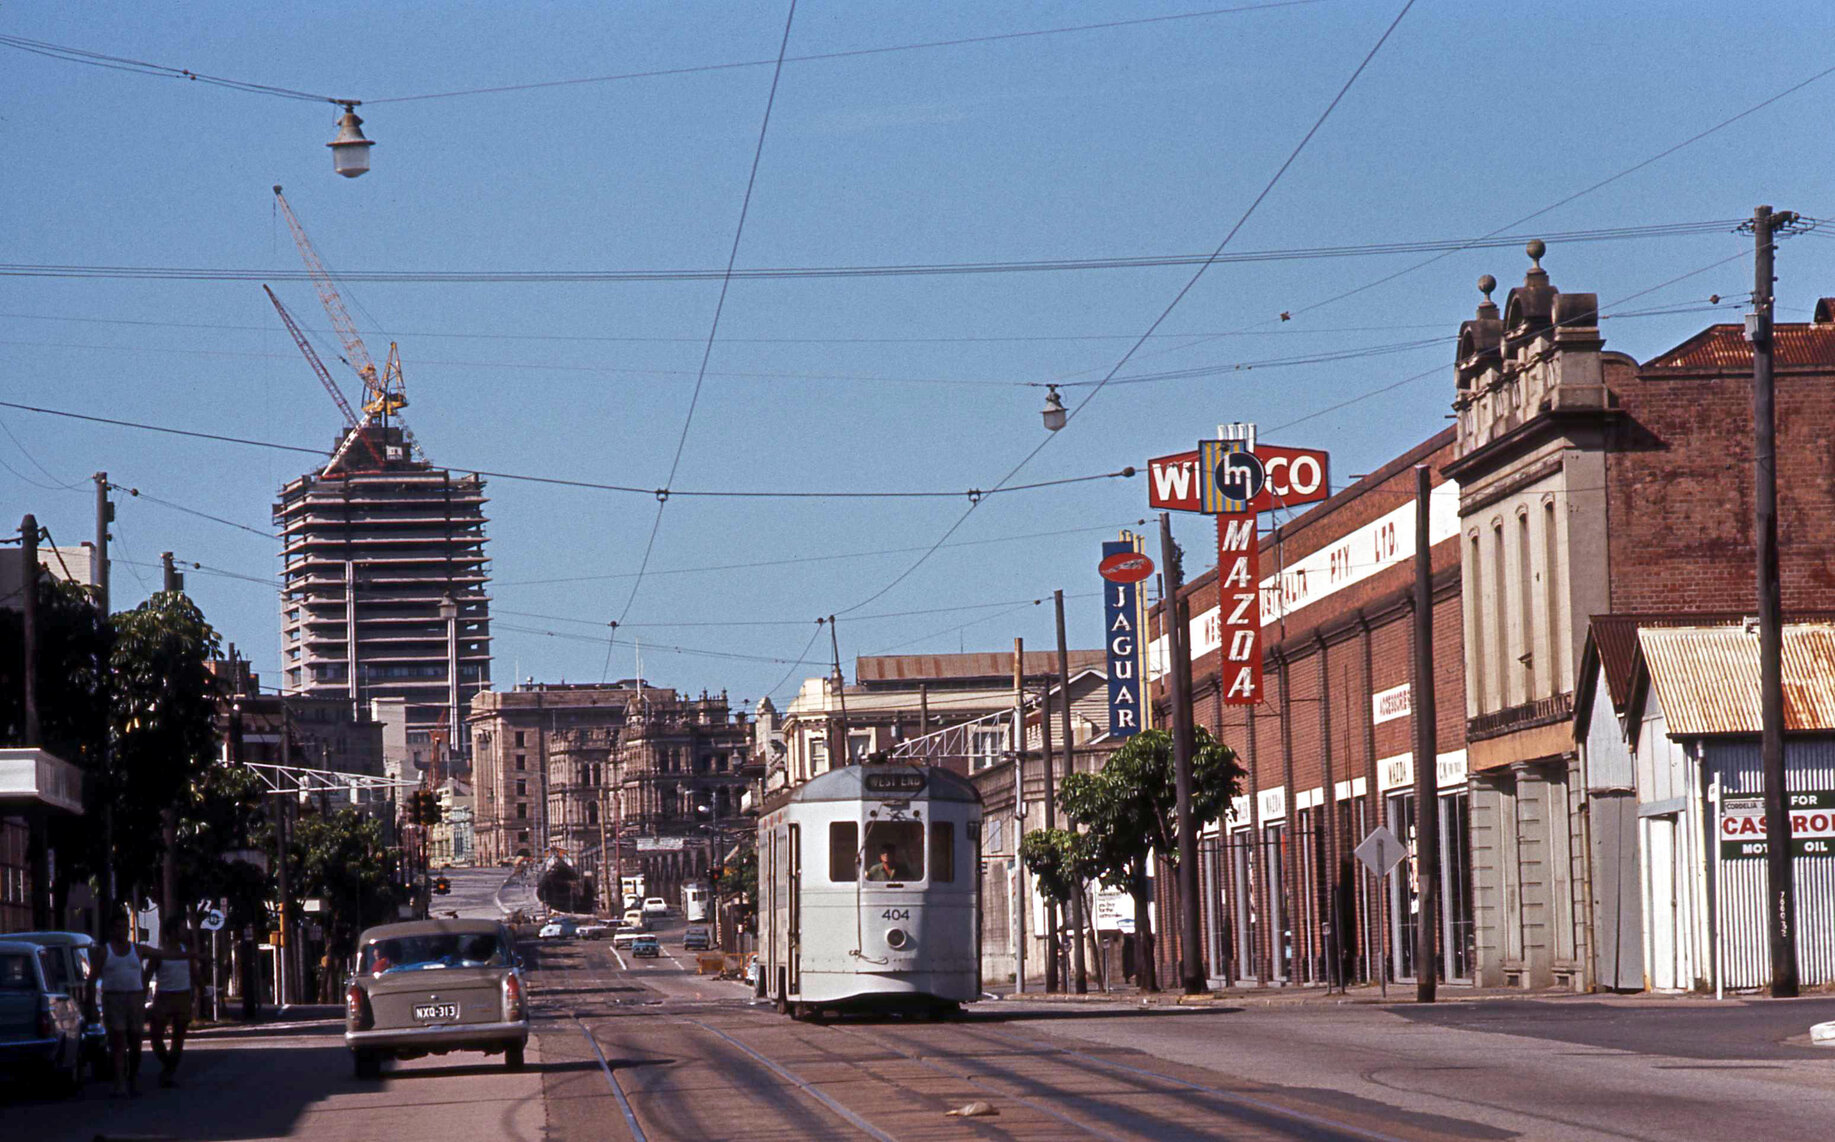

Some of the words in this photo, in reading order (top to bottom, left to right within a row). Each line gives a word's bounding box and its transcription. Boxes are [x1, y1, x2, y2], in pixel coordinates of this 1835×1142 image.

[1374, 522, 1400, 563] LTD.
[1222, 519, 1256, 698] MAZDA
[1112, 586, 1136, 728] JAGUAR
[900, 775, 921, 787] END
[1726, 802, 1757, 810] CORDELIA
[1790, 795, 1818, 806] FOR
[1723, 813, 1835, 835] CASRO
[1803, 841, 1828, 853] OIL
[881, 908, 910, 921] 404
[416, 1005, 456, 1019] NXQ-313
